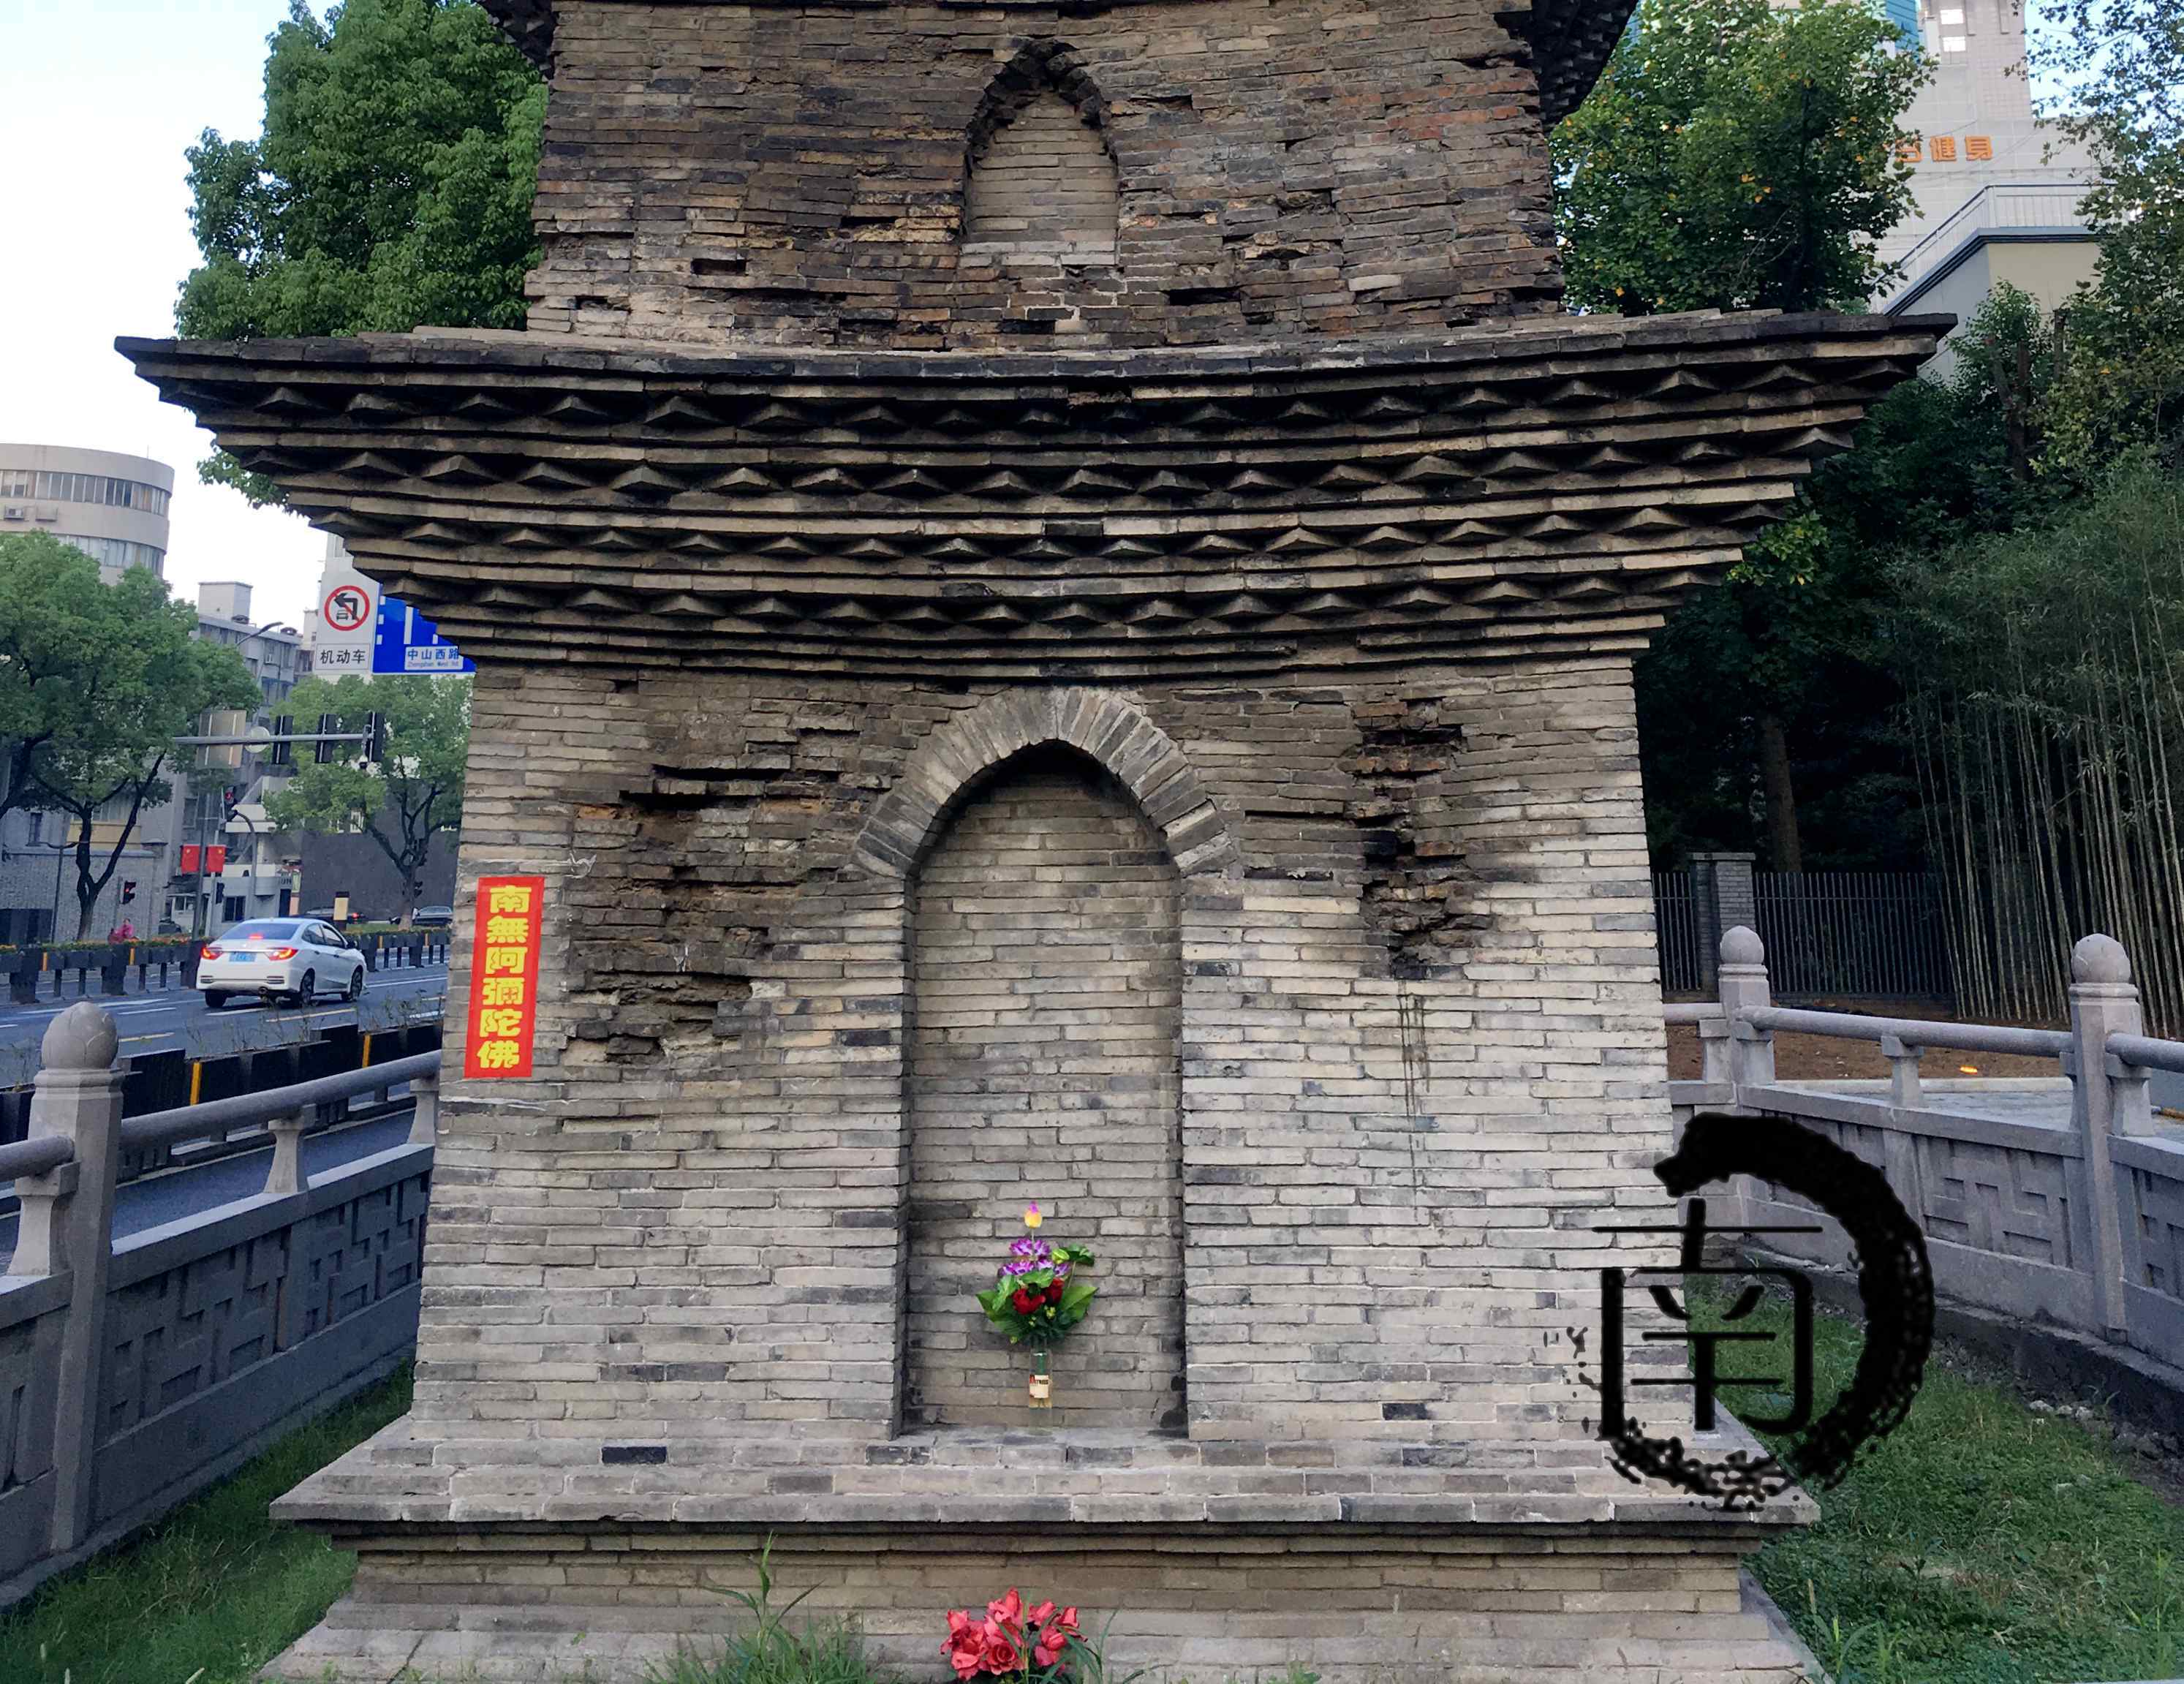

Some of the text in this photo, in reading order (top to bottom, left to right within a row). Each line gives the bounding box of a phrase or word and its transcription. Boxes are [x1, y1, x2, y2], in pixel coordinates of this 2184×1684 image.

[320, 649, 366, 663] 机动车
[407, 648, 458, 660] 中山西路
[477, 885, 532, 1069] 南無阿彌陀佛
